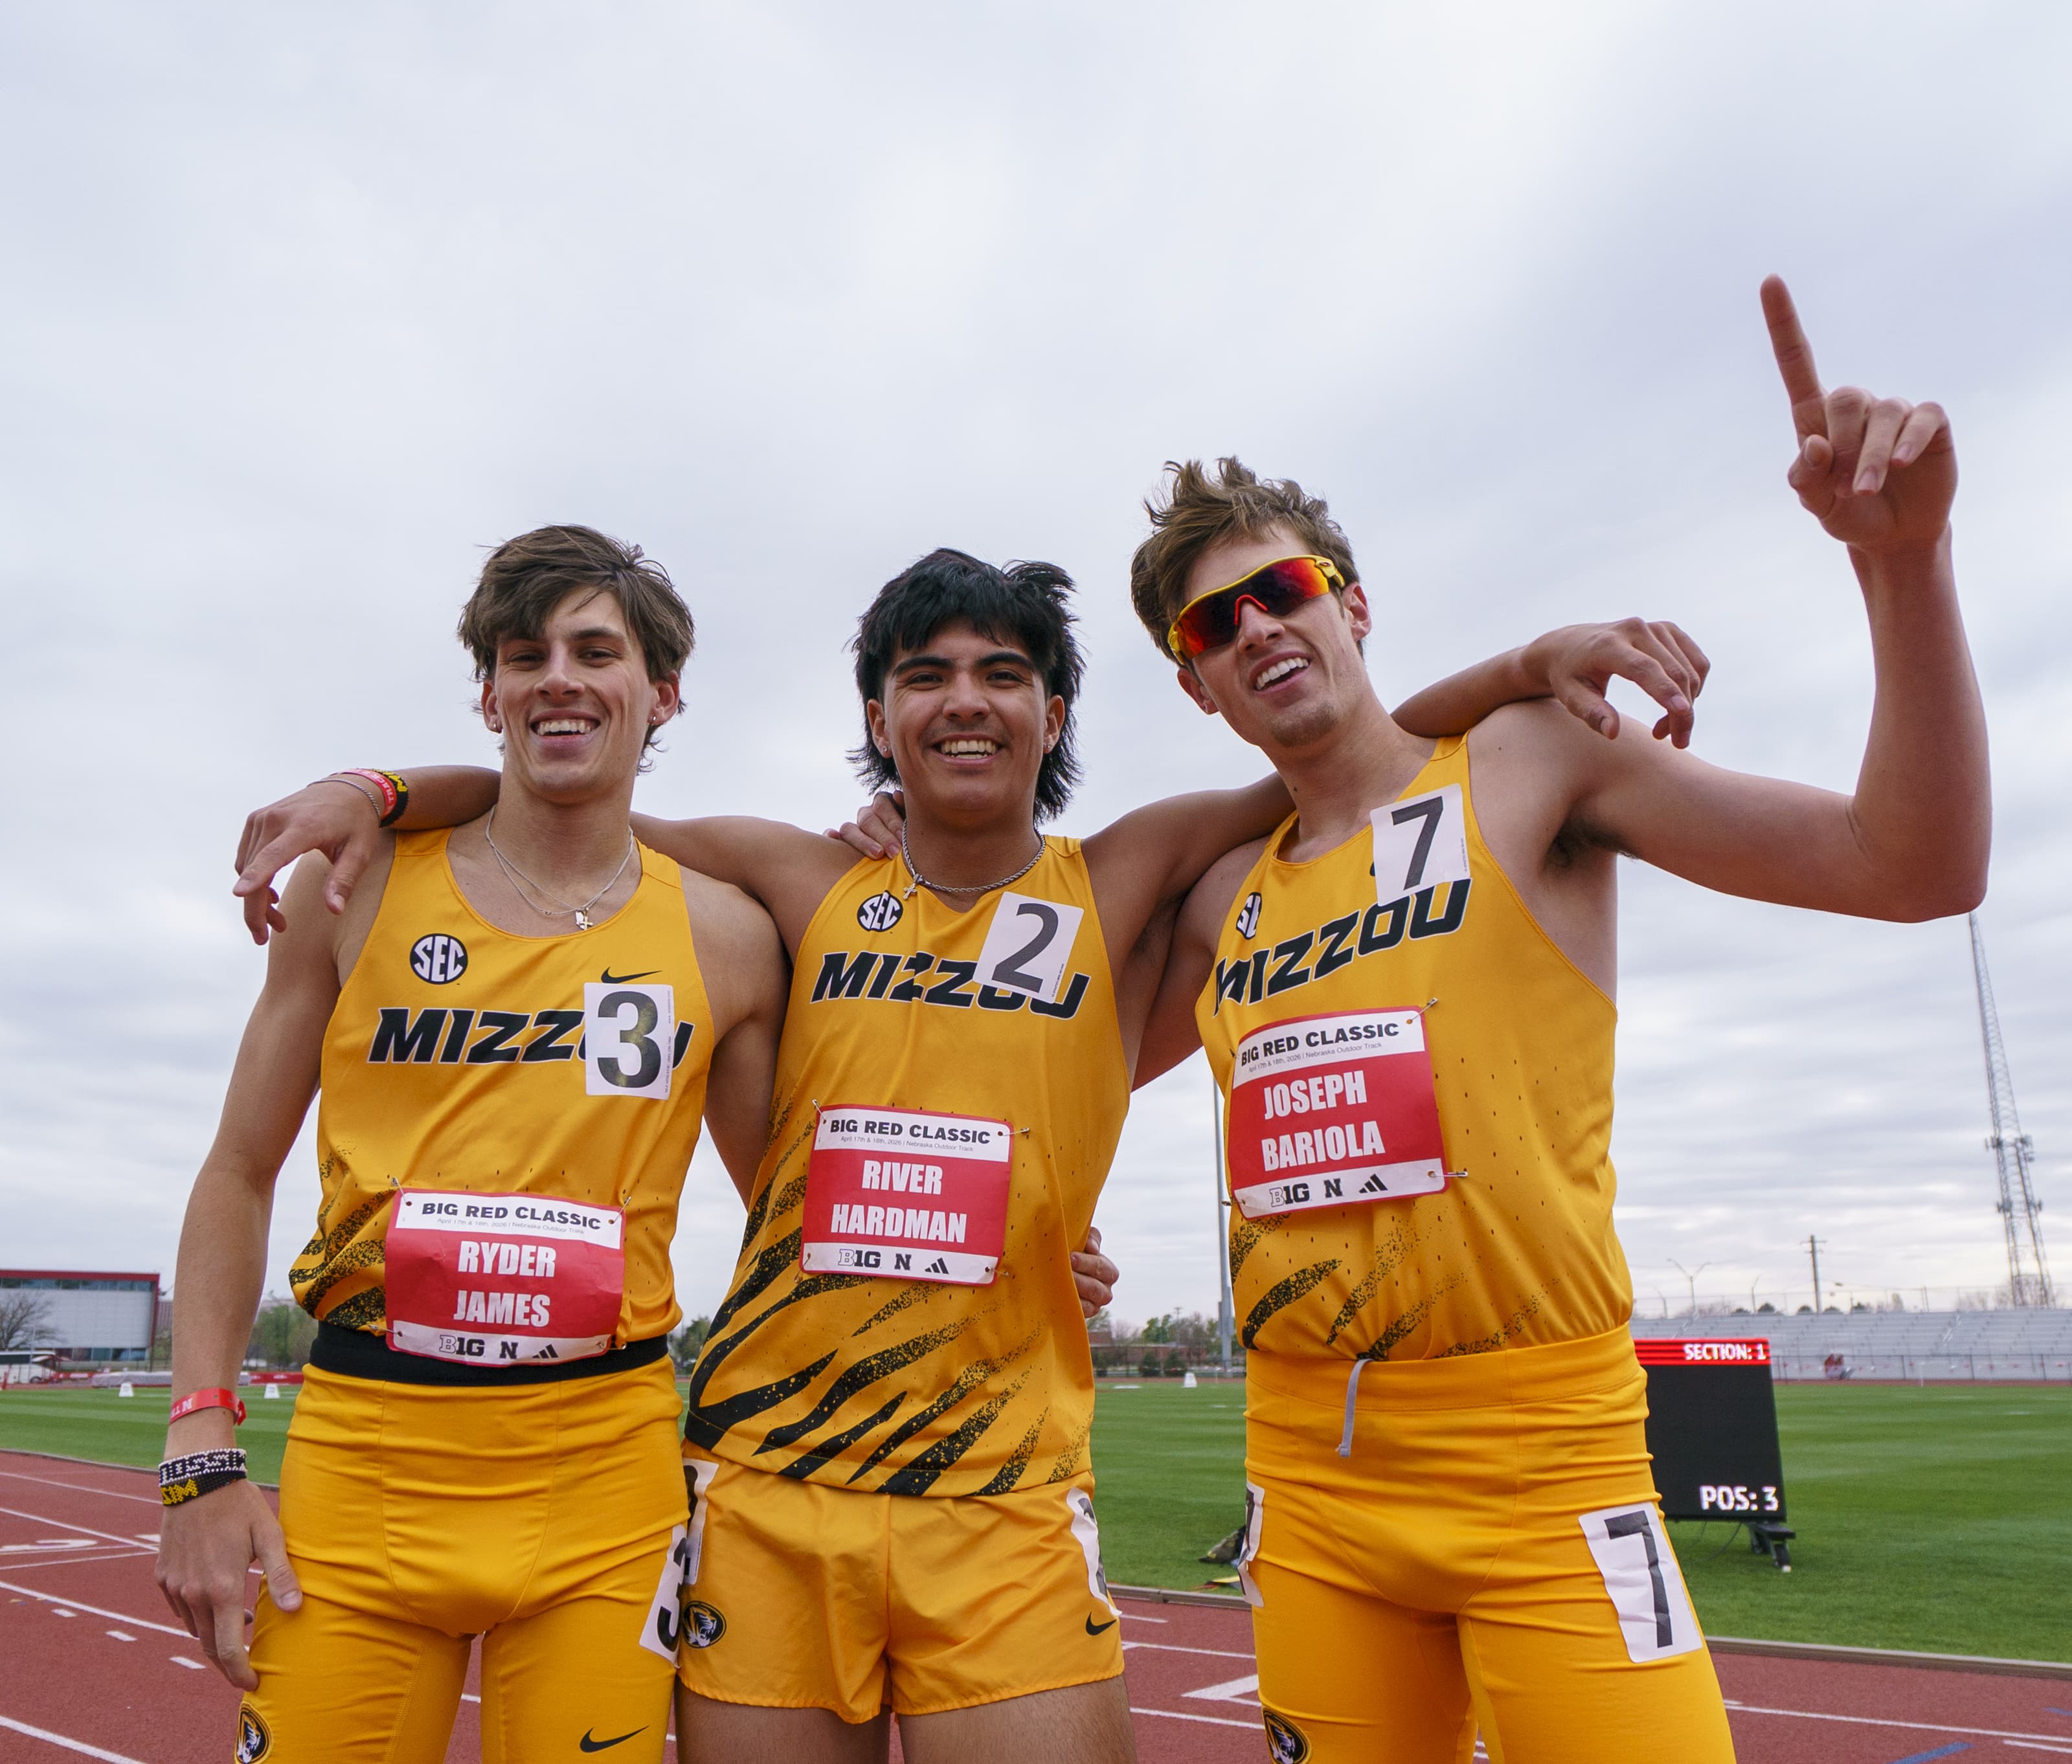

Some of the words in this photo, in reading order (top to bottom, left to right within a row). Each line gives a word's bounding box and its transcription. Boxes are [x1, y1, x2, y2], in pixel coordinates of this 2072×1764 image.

[1391, 796, 1443, 891] 7
[860, 891, 901, 930] SEC
[414, 936, 464, 982] SEC
[991, 902, 1059, 993] 2
[1213, 878, 1472, 1018] MIZZOU
[366, 1007, 694, 1070] MIZZ
[597, 990, 661, 1088] 3
[1241, 1046, 1259, 1066] BIG
[1263, 1036, 1299, 1057] RED
[1305, 1023, 1399, 1047] CLASSIC
[1306, 1049, 1335, 1058] Nebraska
[1336, 1045, 1363, 1053] Outdoor
[1264, 1071, 1368, 1120] JOSEPH
[830, 1119, 858, 1133] BIG
[864, 1121, 903, 1136] RED
[909, 1124, 991, 1144] CLASSIC
[1261, 1120, 1386, 1172] BARIOLA
[861, 1159, 943, 1196] RIVER
[1323, 1178, 1343, 1198] N
[422, 1203, 458, 1216] BIG
[466, 1205, 508, 1218] RED
[515, 1206, 601, 1230] CLASSIC
[830, 1203, 967, 1244] HARDMAN
[458, 1240, 557, 1278] RYDER
[894, 1253, 912, 1270] N
[453, 1291, 550, 1327] JAMES
[499, 1341, 518, 1359] N
[1684, 1343, 1752, 1360] SECTION:
[1757, 1343, 1766, 1360] 1
[1700, 1485, 1758, 1511] POS:
[1762, 1486, 1779, 1511] 3
[1604, 1510, 1672, 1648] 7
